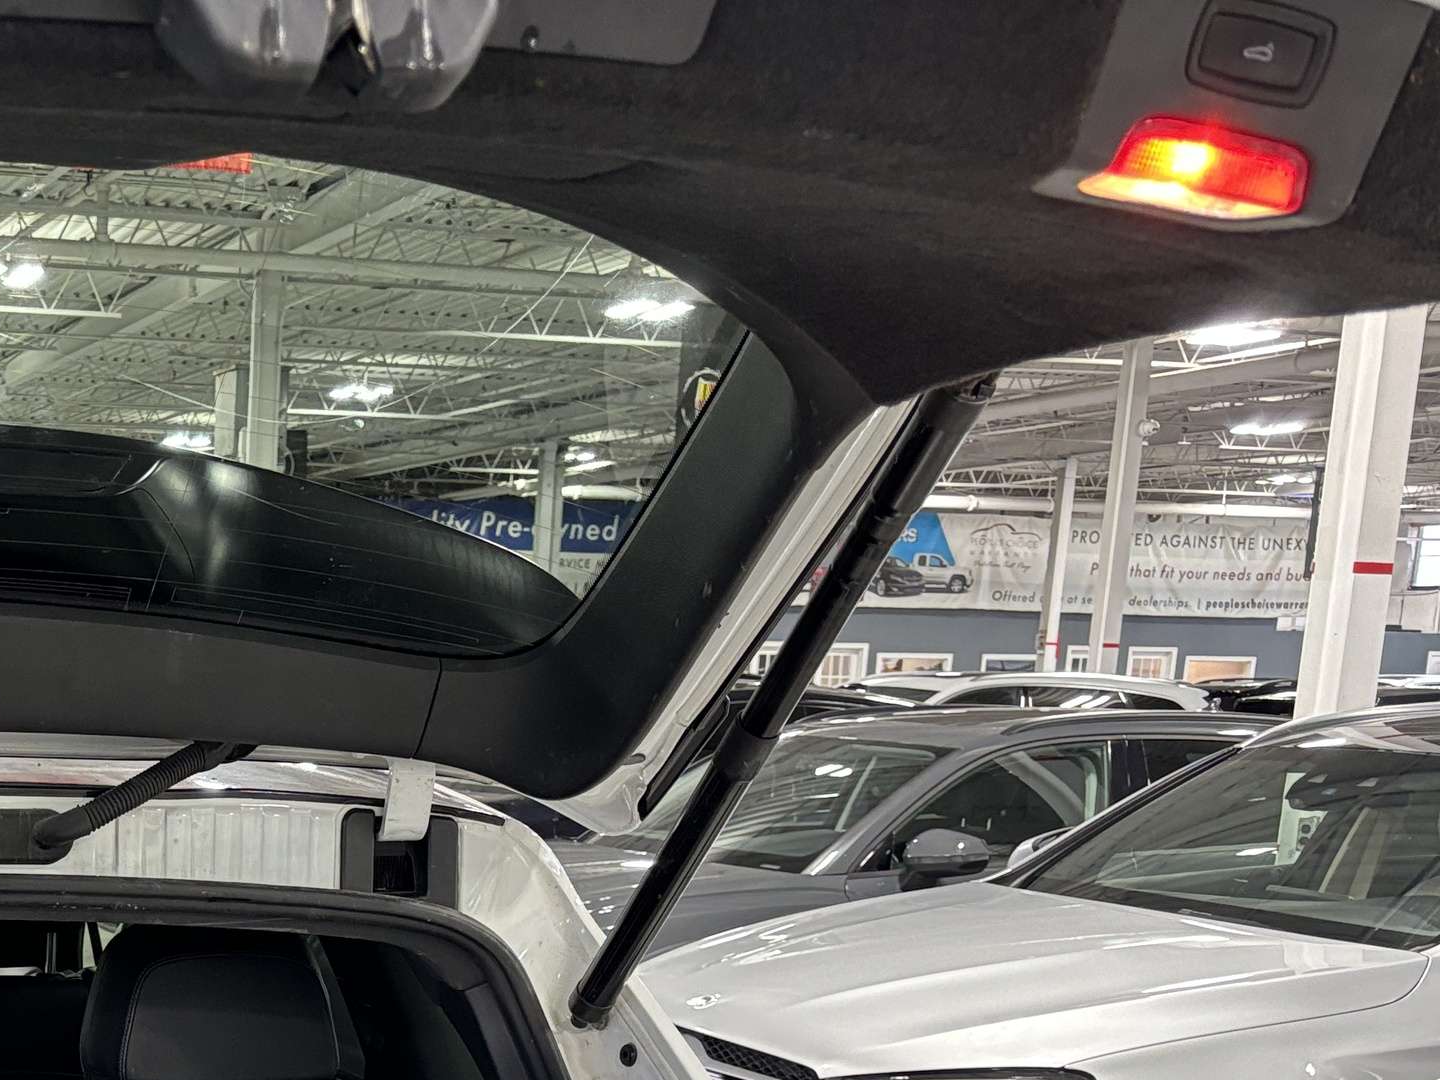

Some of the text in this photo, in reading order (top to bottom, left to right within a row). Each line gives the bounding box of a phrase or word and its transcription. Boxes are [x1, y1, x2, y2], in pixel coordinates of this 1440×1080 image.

[1160, 534, 1225, 549] AGAINST
[1231, 536, 1255, 550] THE
[1129, 563, 1156, 579] that
[1160, 564, 1175, 580] fit
[1178, 569, 1208, 583] your
[1213, 567, 1251, 581] needs
[1256, 568, 1281, 582] and
[992, 590, 1035, 603] Offered
